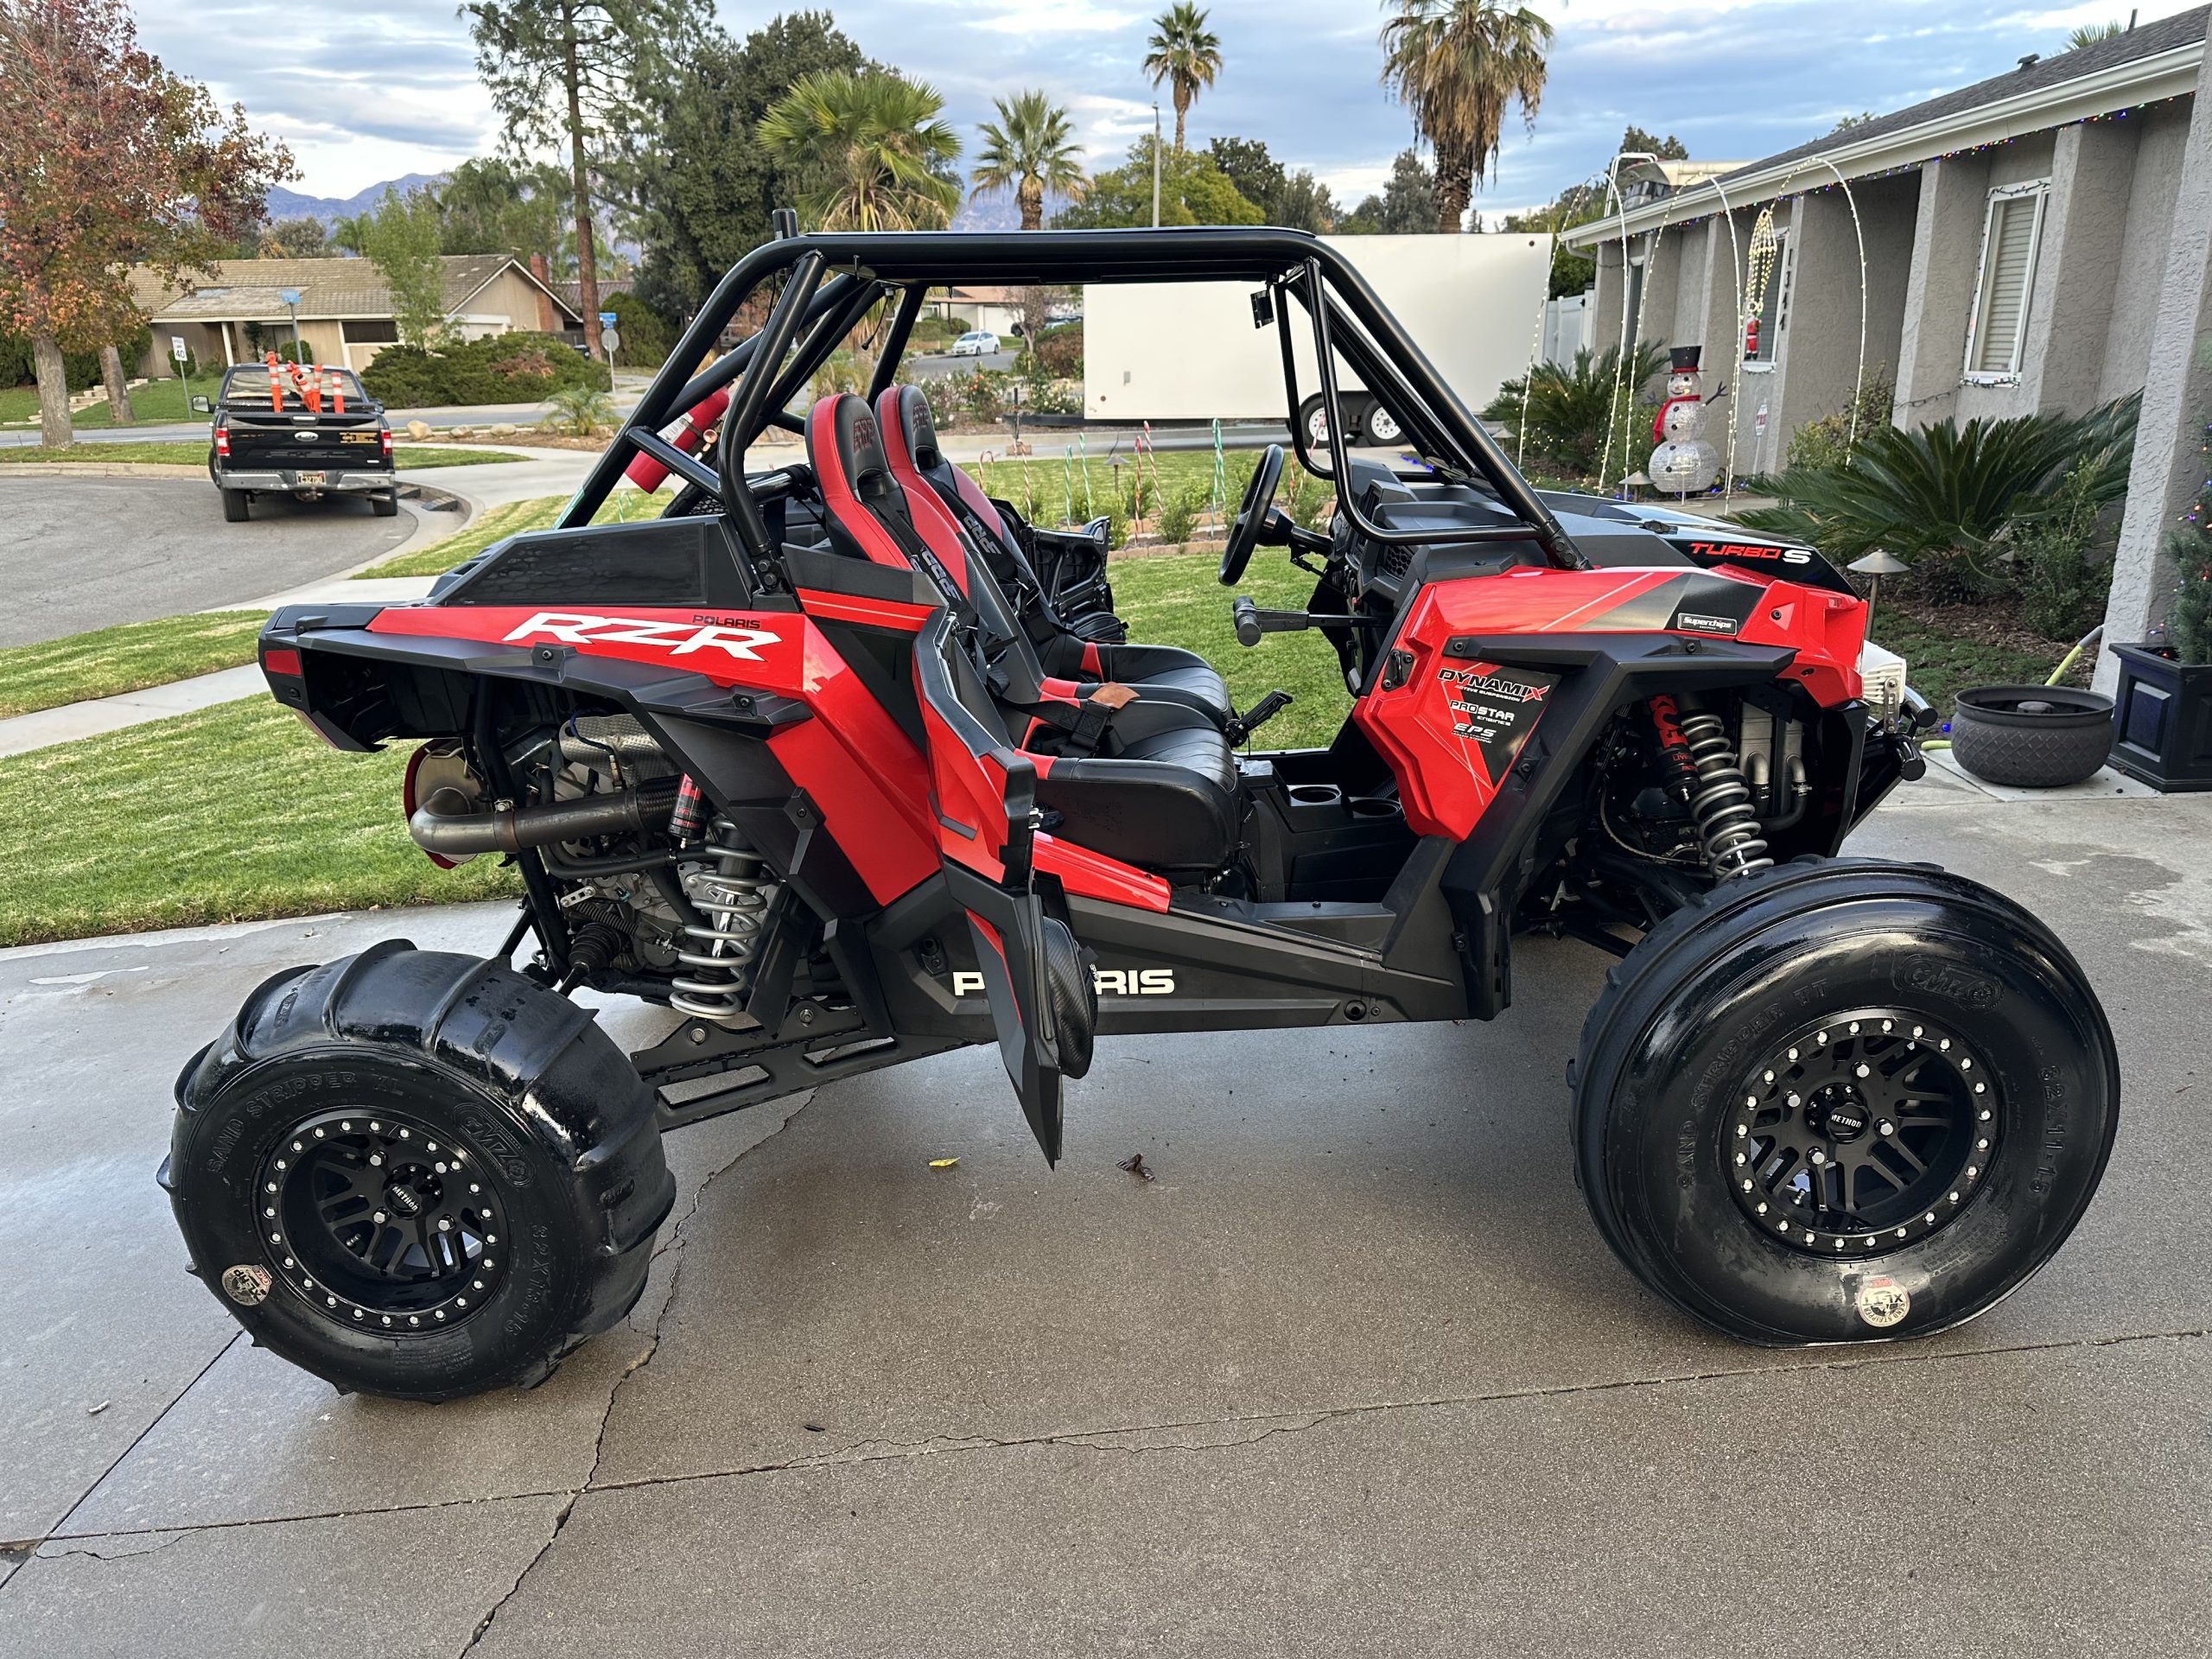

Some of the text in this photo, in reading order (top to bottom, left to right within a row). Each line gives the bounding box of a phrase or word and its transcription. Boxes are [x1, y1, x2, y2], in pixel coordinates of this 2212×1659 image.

[1780, 248, 1794, 331] 1344
[175, 349, 186, 359] 40
[1689, 542, 1812, 564] TURBO S
[692, 614, 761, 630] POLARIS
[1683, 616, 1732, 629] Superchips
[501, 612, 783, 662] RZR
[1437, 667, 1551, 703] DYNAMIX
[1453, 684, 1521, 702] ACTIVE SUSPENSION
[1453, 722, 1497, 738] EPS
[206, 1118, 245, 1175] SAND
[245, 1071, 357, 1119] STRIPPER
[1830, 1115, 1863, 1128] METHOD
[391, 1184, 419, 1211] METHOD
[1864, 1307, 1893, 1323] STRIPPER
